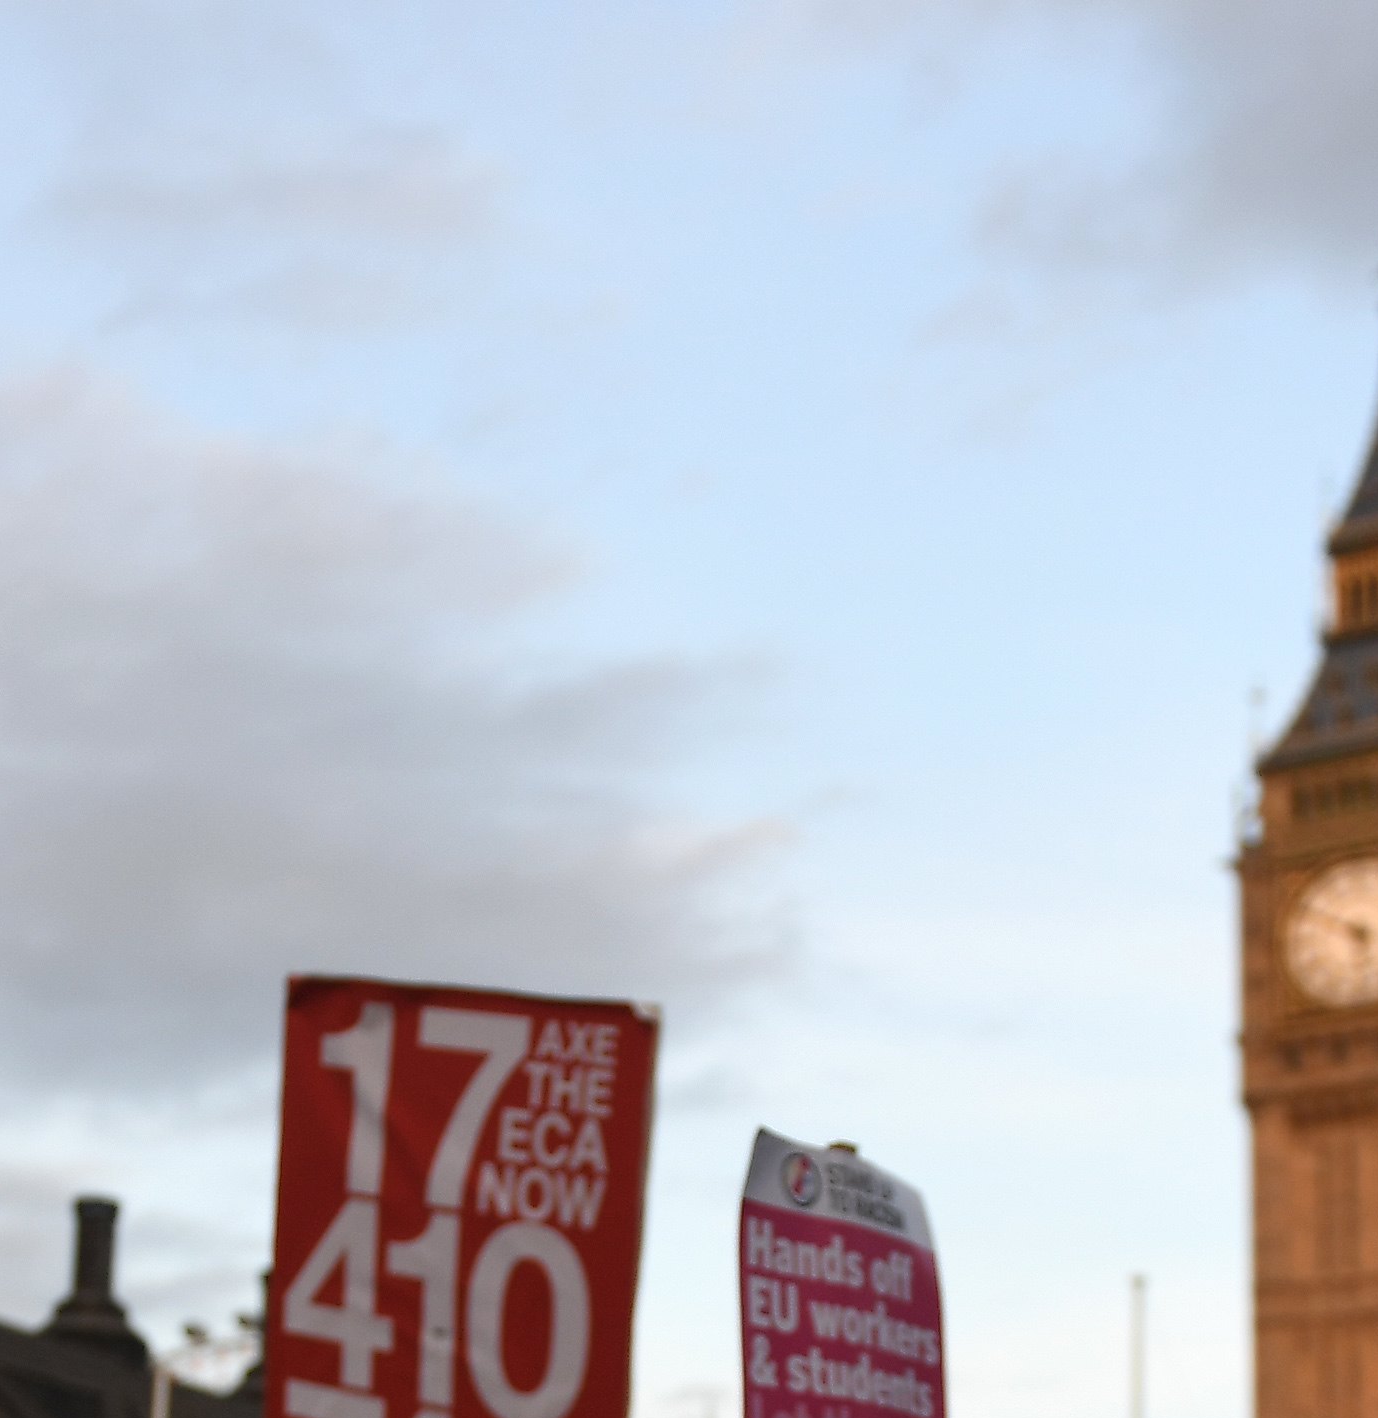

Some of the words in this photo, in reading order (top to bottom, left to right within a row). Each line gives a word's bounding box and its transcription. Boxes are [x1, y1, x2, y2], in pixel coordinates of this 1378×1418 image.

[534, 1017, 620, 1068] AXE
[319, 1000, 534, 1208] 17
[525, 1060, 617, 1118] THE
[498, 1104, 608, 1174] ECA
[476, 1160, 608, 1232] NOW
[746, 1216, 865, 1289] Hands
[871, 1250, 913, 1301] off
[748, 1274, 800, 1334] EU
[808, 1300, 940, 1366] workers
[750, 1334, 779, 1389] &
